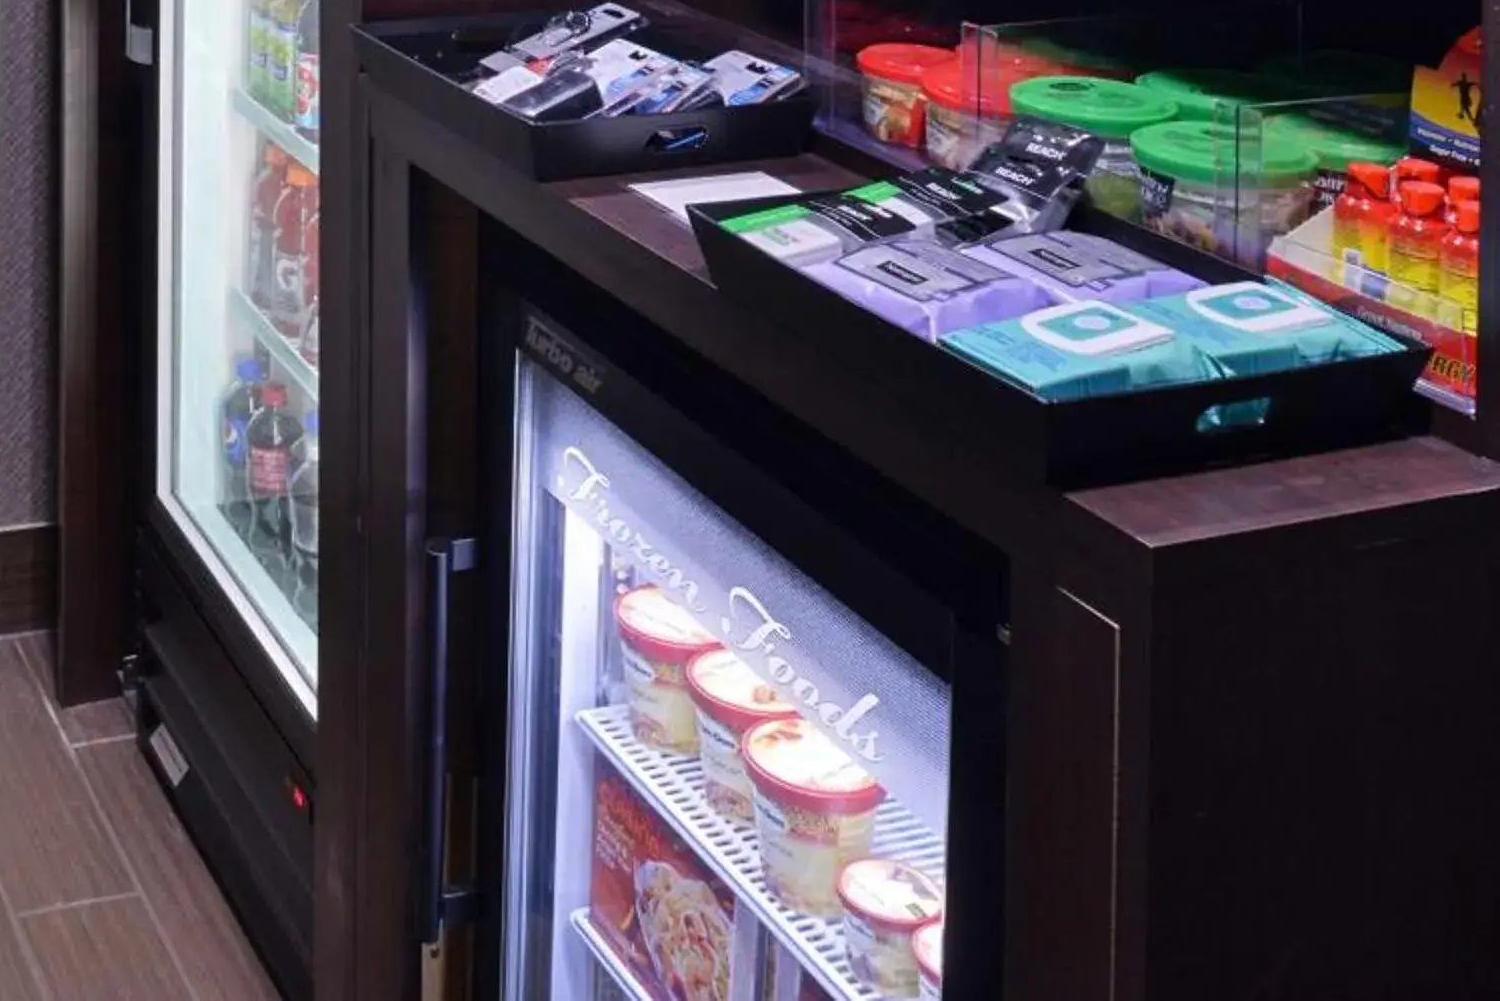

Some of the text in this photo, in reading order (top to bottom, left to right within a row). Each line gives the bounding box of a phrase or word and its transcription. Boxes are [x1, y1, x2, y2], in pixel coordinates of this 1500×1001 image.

[1026, 142, 1067, 159] REACH
[995, 166, 1036, 186] REACH
[557, 446, 881, 763] Frozen Foods
